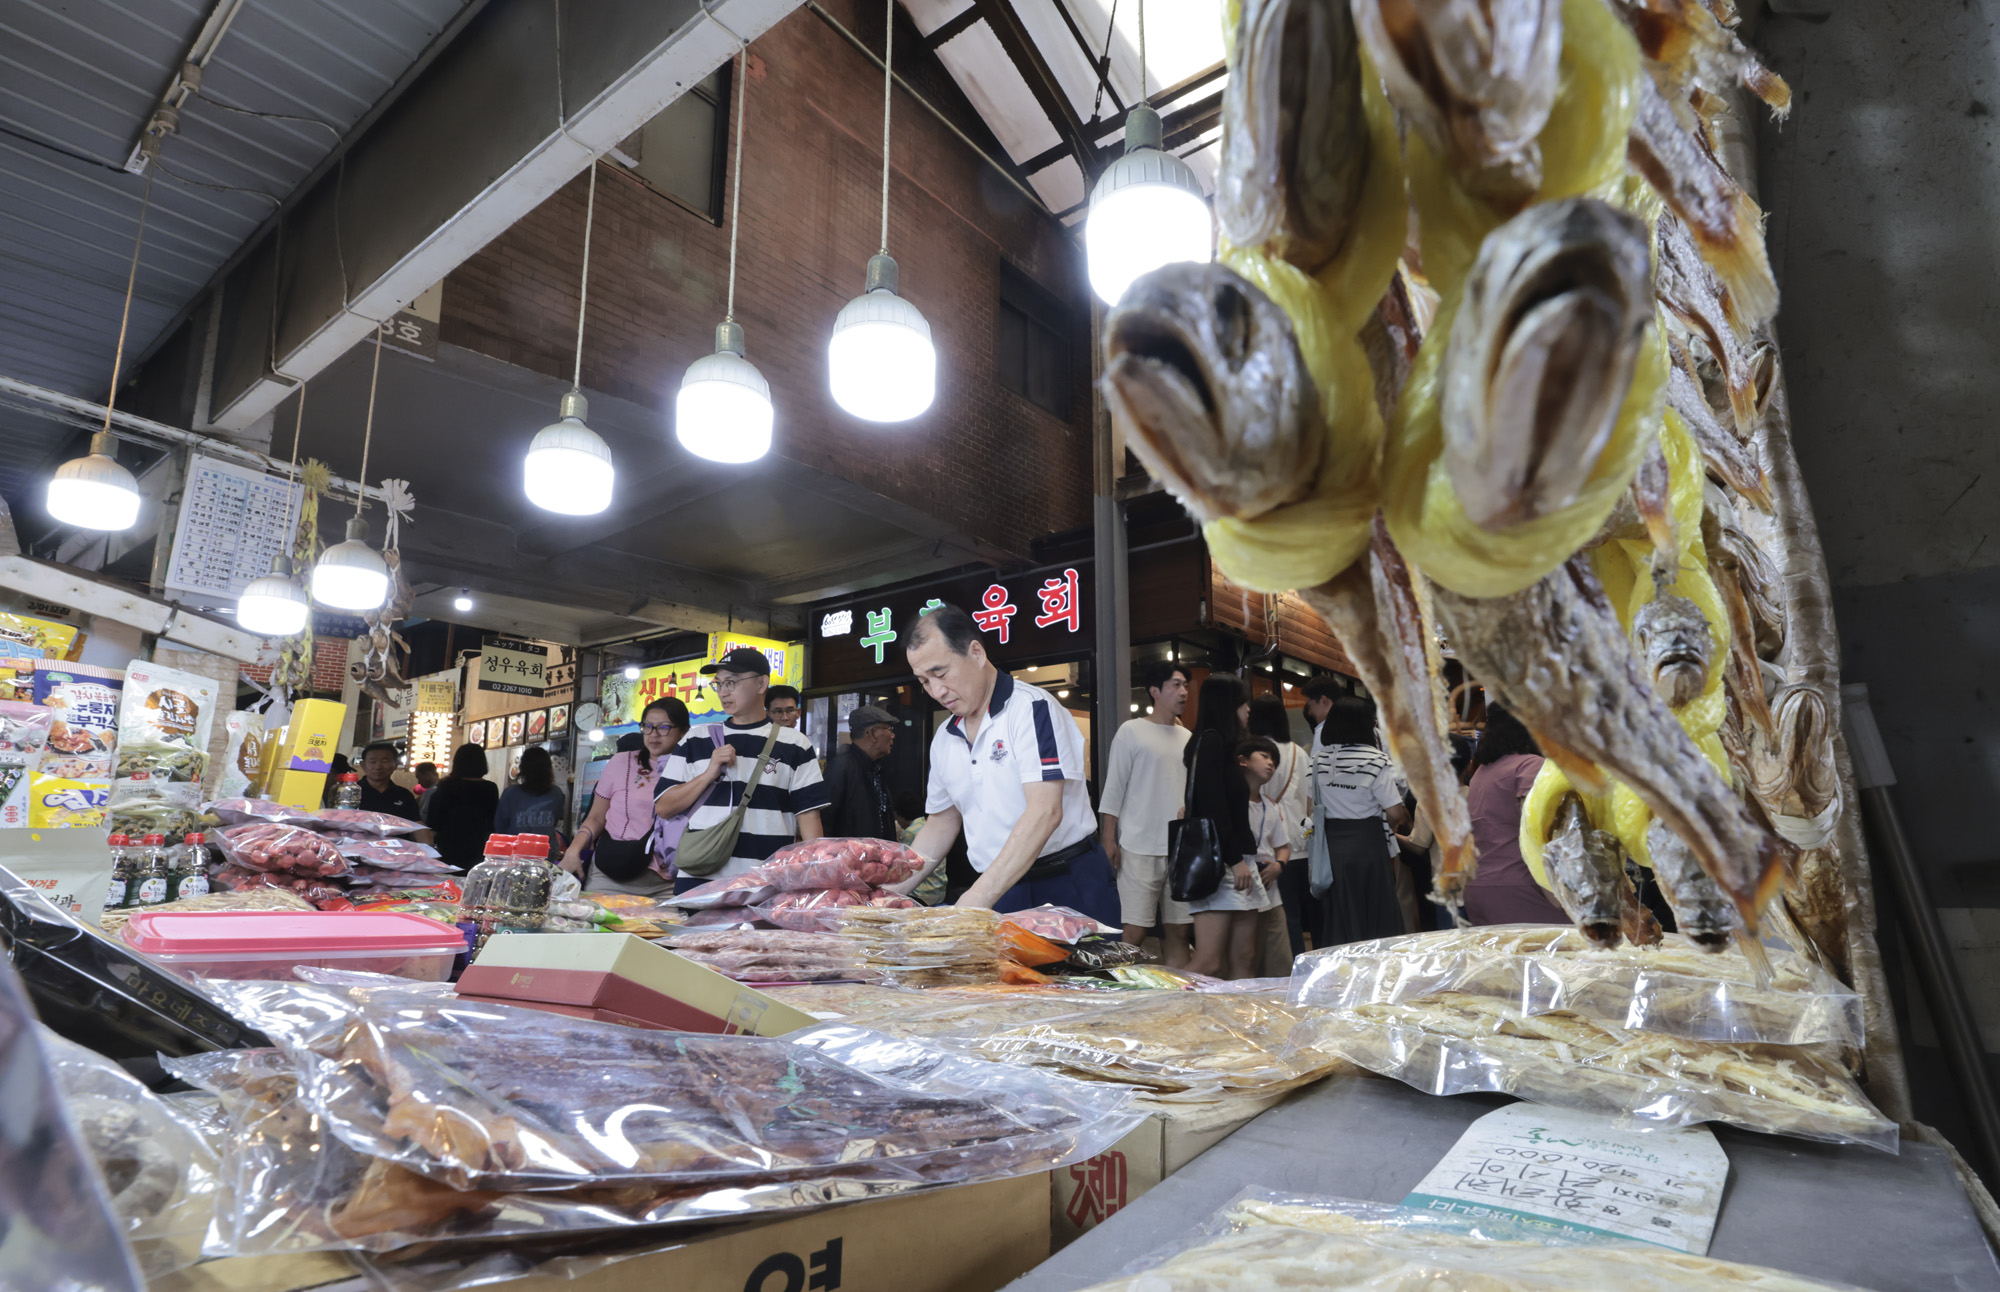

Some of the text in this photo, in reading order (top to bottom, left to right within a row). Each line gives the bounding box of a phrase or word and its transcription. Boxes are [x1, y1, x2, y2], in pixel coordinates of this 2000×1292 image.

[860, 568, 1079, 663] 부육회
[484, 655, 543, 680] 성우육회
[492, 683, 533, 695] 02 2267 1010
[422, 718, 441, 762] 성우육회
[1469, 1158, 1602, 1190] 러시아
[1612, 1185, 1680, 1210] 원산지
